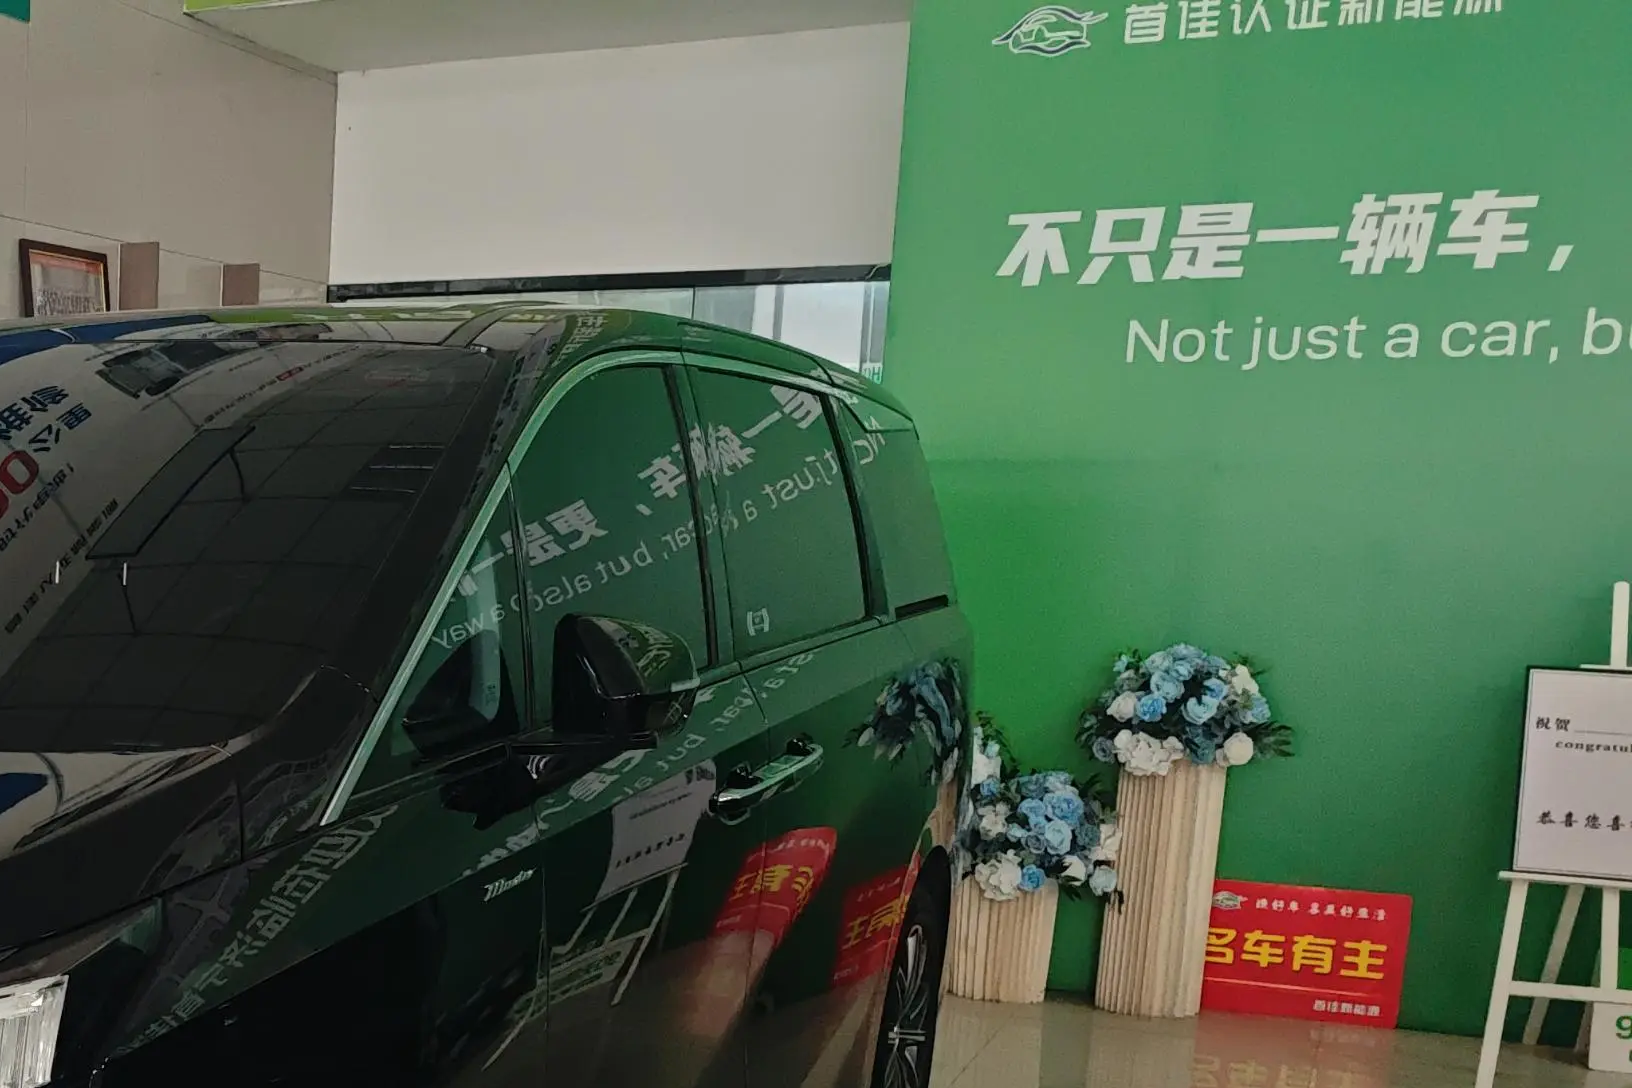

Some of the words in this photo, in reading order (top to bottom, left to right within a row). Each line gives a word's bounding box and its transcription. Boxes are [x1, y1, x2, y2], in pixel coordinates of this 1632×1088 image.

[1125, 318, 1234, 364] Not
[1243, 315, 1367, 370] just
[1383, 322, 1420, 361] a
[1440, 318, 1561, 365] car,
[1582, 307, 1632, 356] b
[1535, 716, 1571, 732] 祝贺
[1536, 810, 1632, 831] 恭喜您喜
[1204, 927, 1388, 980] 名车有主
